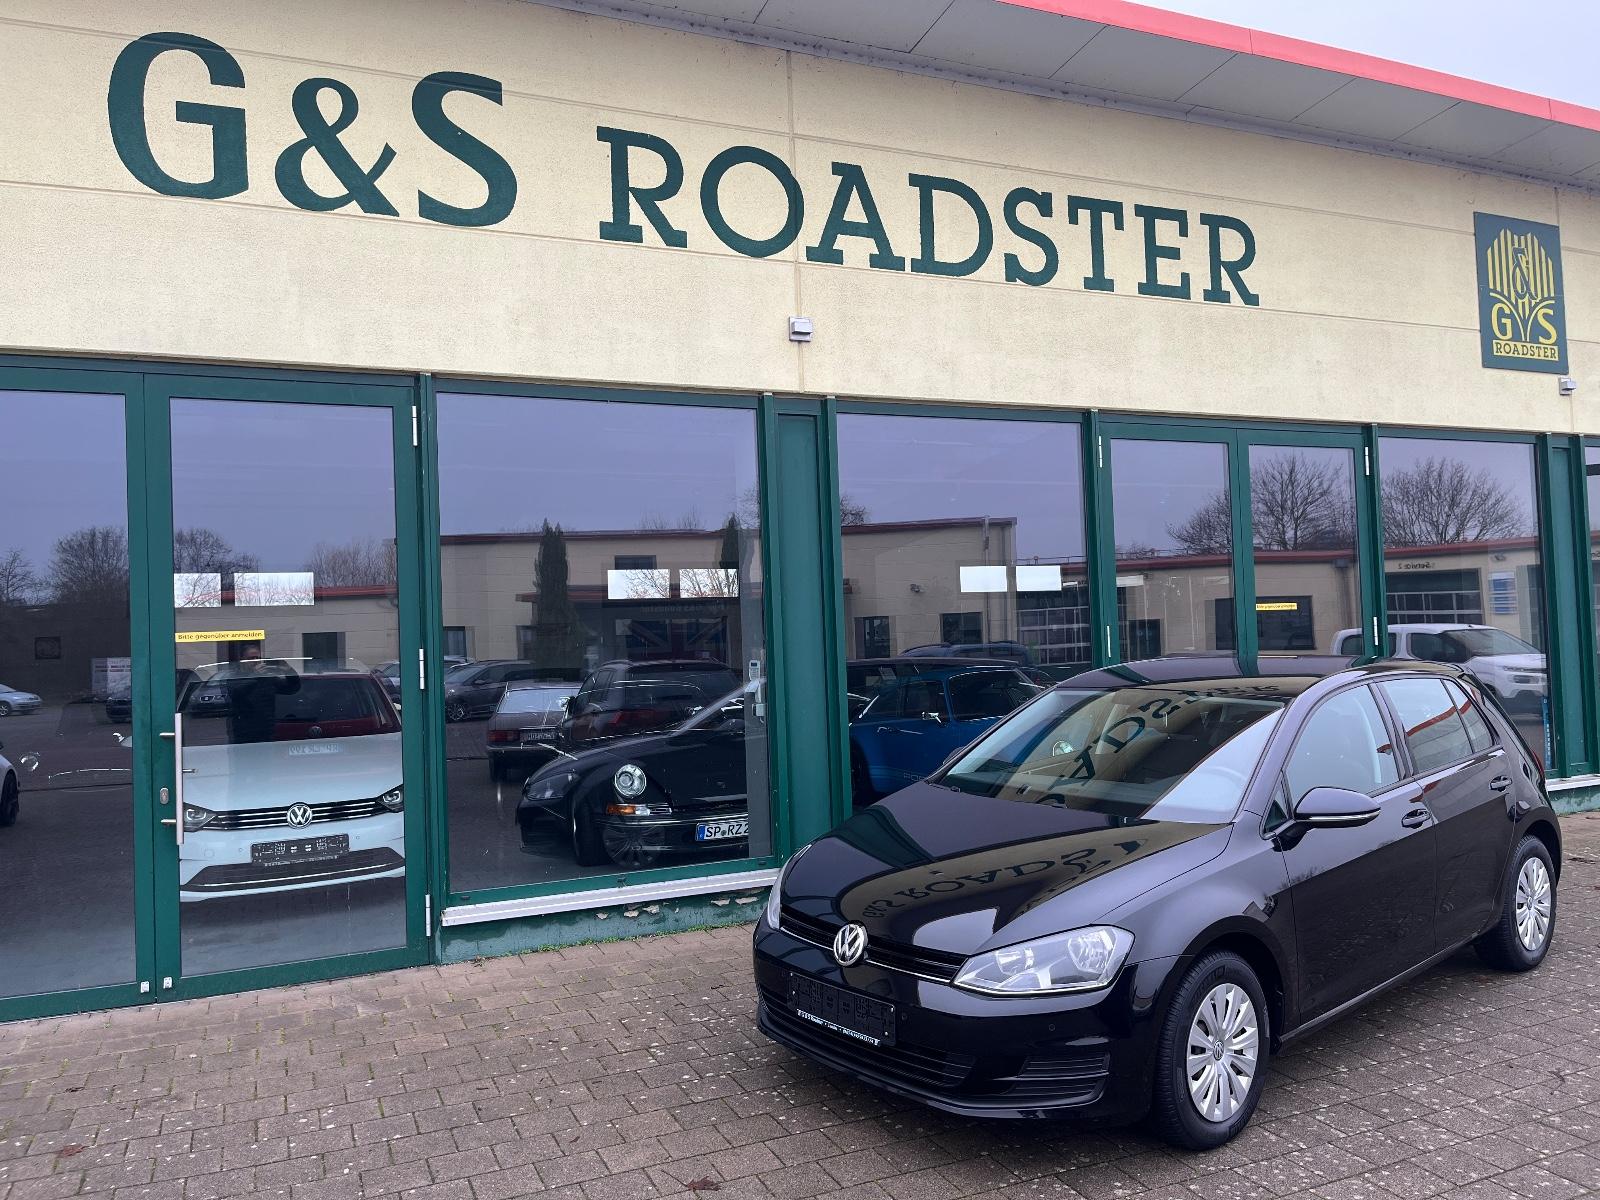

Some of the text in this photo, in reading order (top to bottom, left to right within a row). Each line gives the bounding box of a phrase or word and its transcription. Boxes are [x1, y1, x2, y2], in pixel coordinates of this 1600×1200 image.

[107, 31, 1260, 306] G&S ROADSTER
[1494, 341, 1559, 360] ROADSTER
